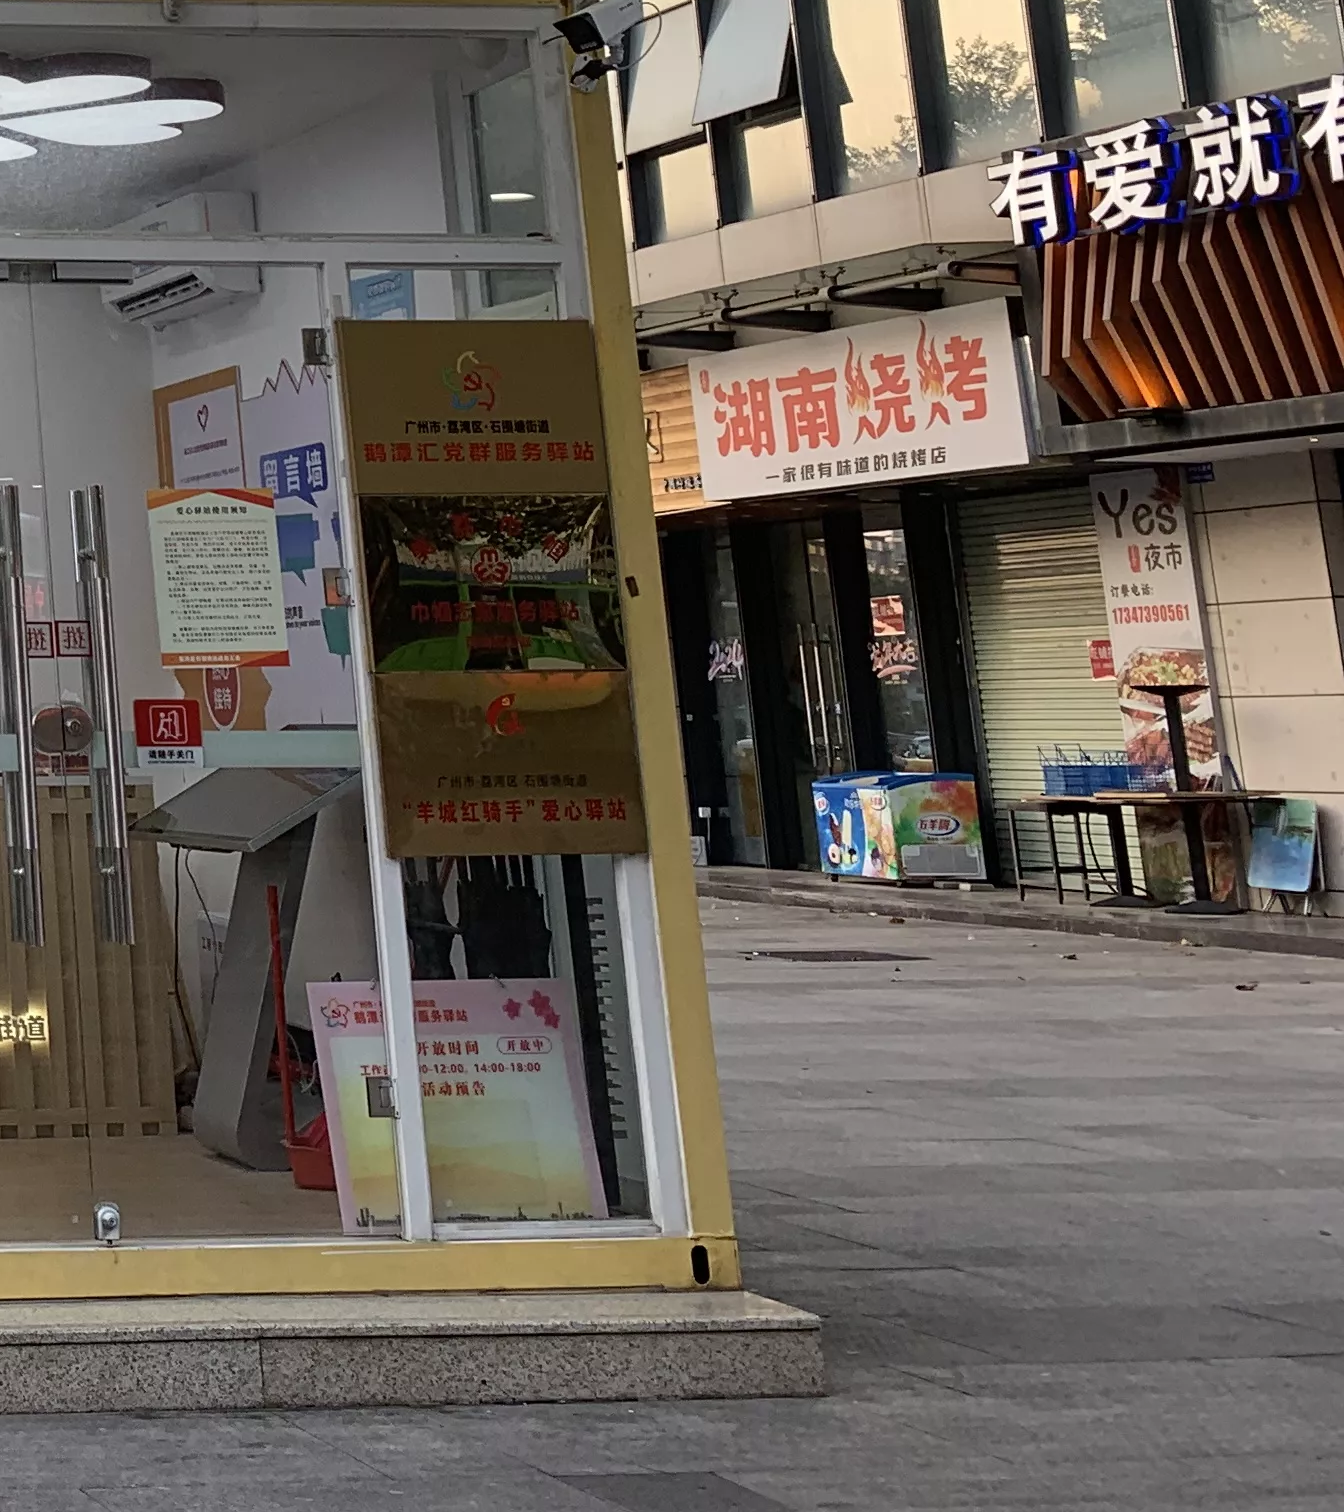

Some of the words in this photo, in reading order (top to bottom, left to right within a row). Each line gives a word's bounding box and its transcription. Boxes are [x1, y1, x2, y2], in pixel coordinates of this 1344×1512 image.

[714, 319, 988, 457] 湖南烧烤
[405, 419, 550, 434] 广州市·荔湾区·石围塘街道
[363, 441, 595, 463] 鹅潭汇党群服务驿站
[765, 446, 947, 484] 一家很有味道的烧烤店
[1097, 487, 1178, 538] Yes
[1144, 542, 1182, 571] 夜市
[1112, 603, 1191, 625] 17347390561
[402, 797, 627, 824] “羊城红骑手”爱心驿站
[354, 1009, 469, 1024] 鹅潭服务驿站
[506, 1039, 544, 1051] 开放中
